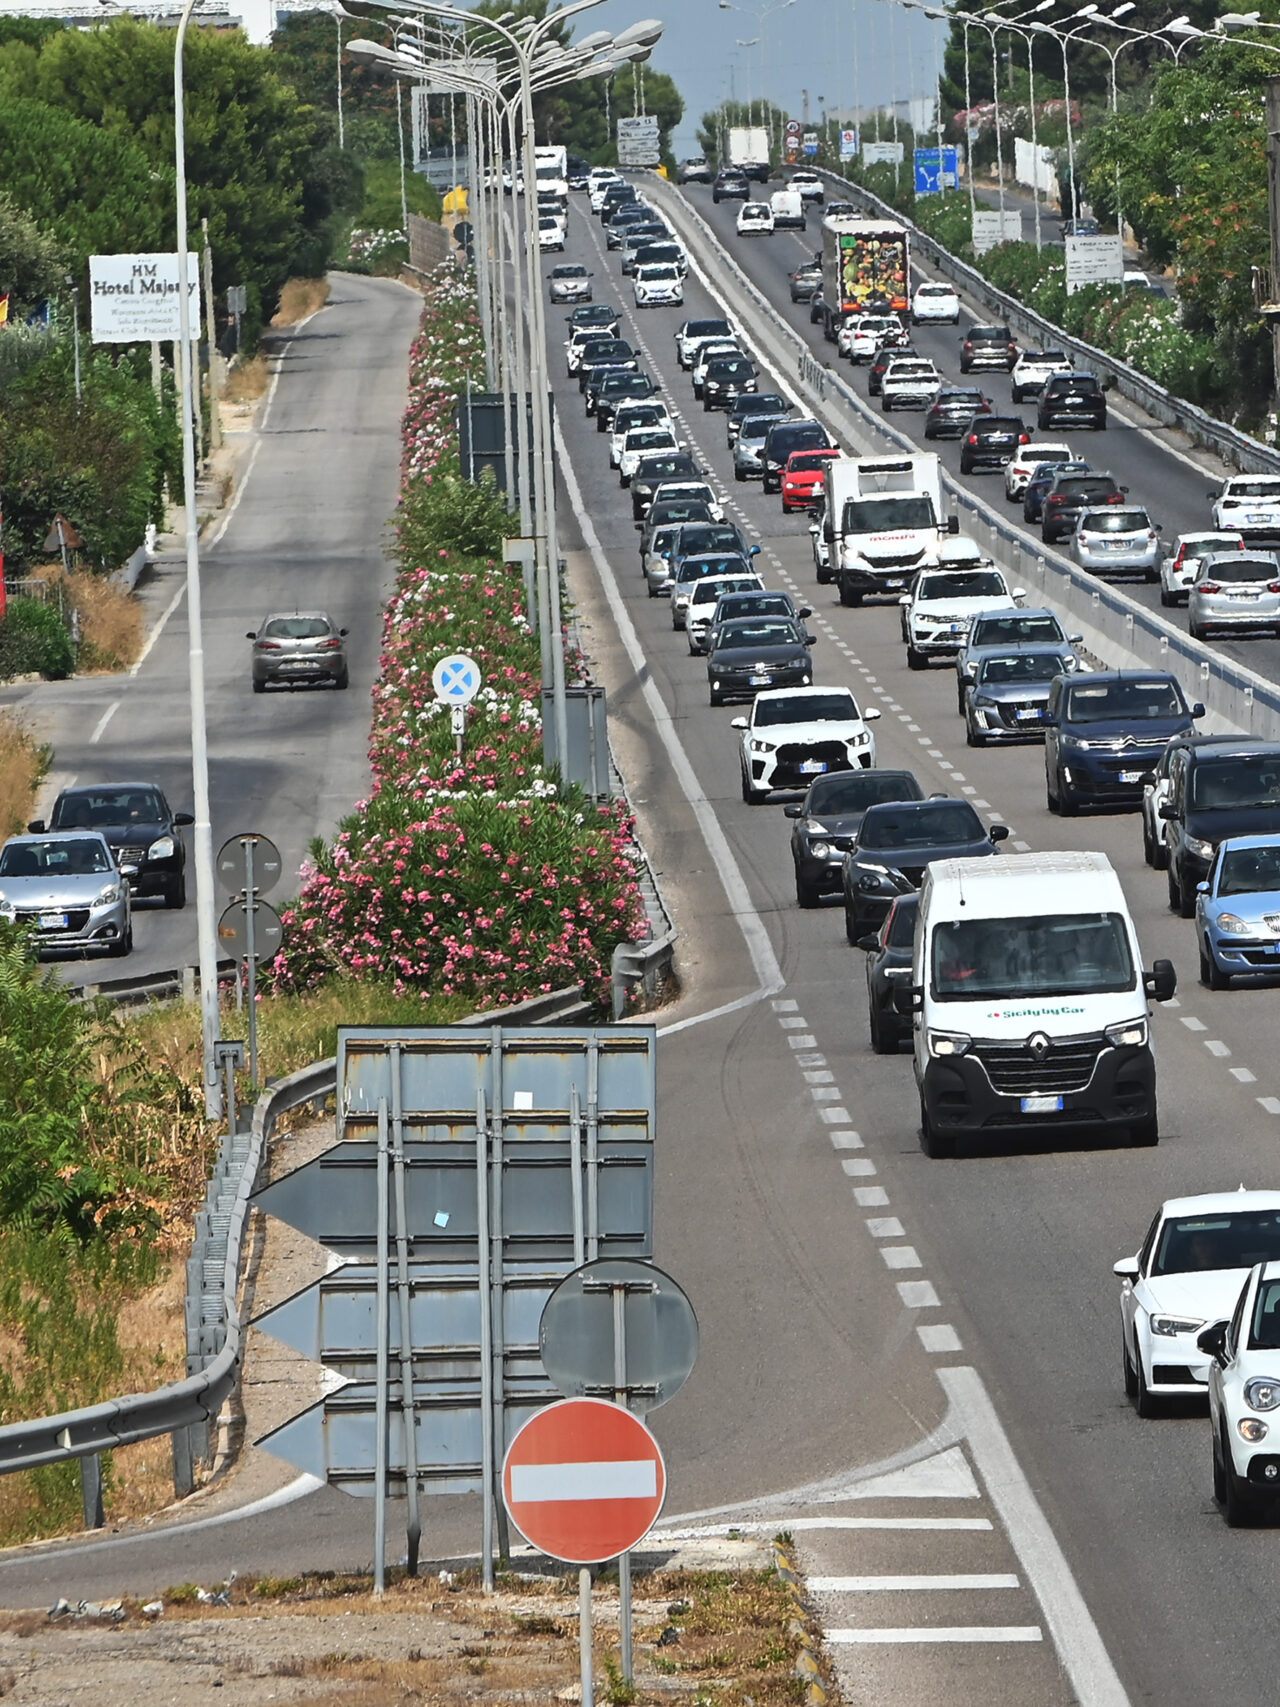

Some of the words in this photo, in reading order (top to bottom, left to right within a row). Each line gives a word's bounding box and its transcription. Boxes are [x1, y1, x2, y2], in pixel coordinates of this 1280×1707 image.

[132, 264, 157, 277] HM
[93, 280, 134, 296] Hotel
[140, 279, 197, 298] Majesy
